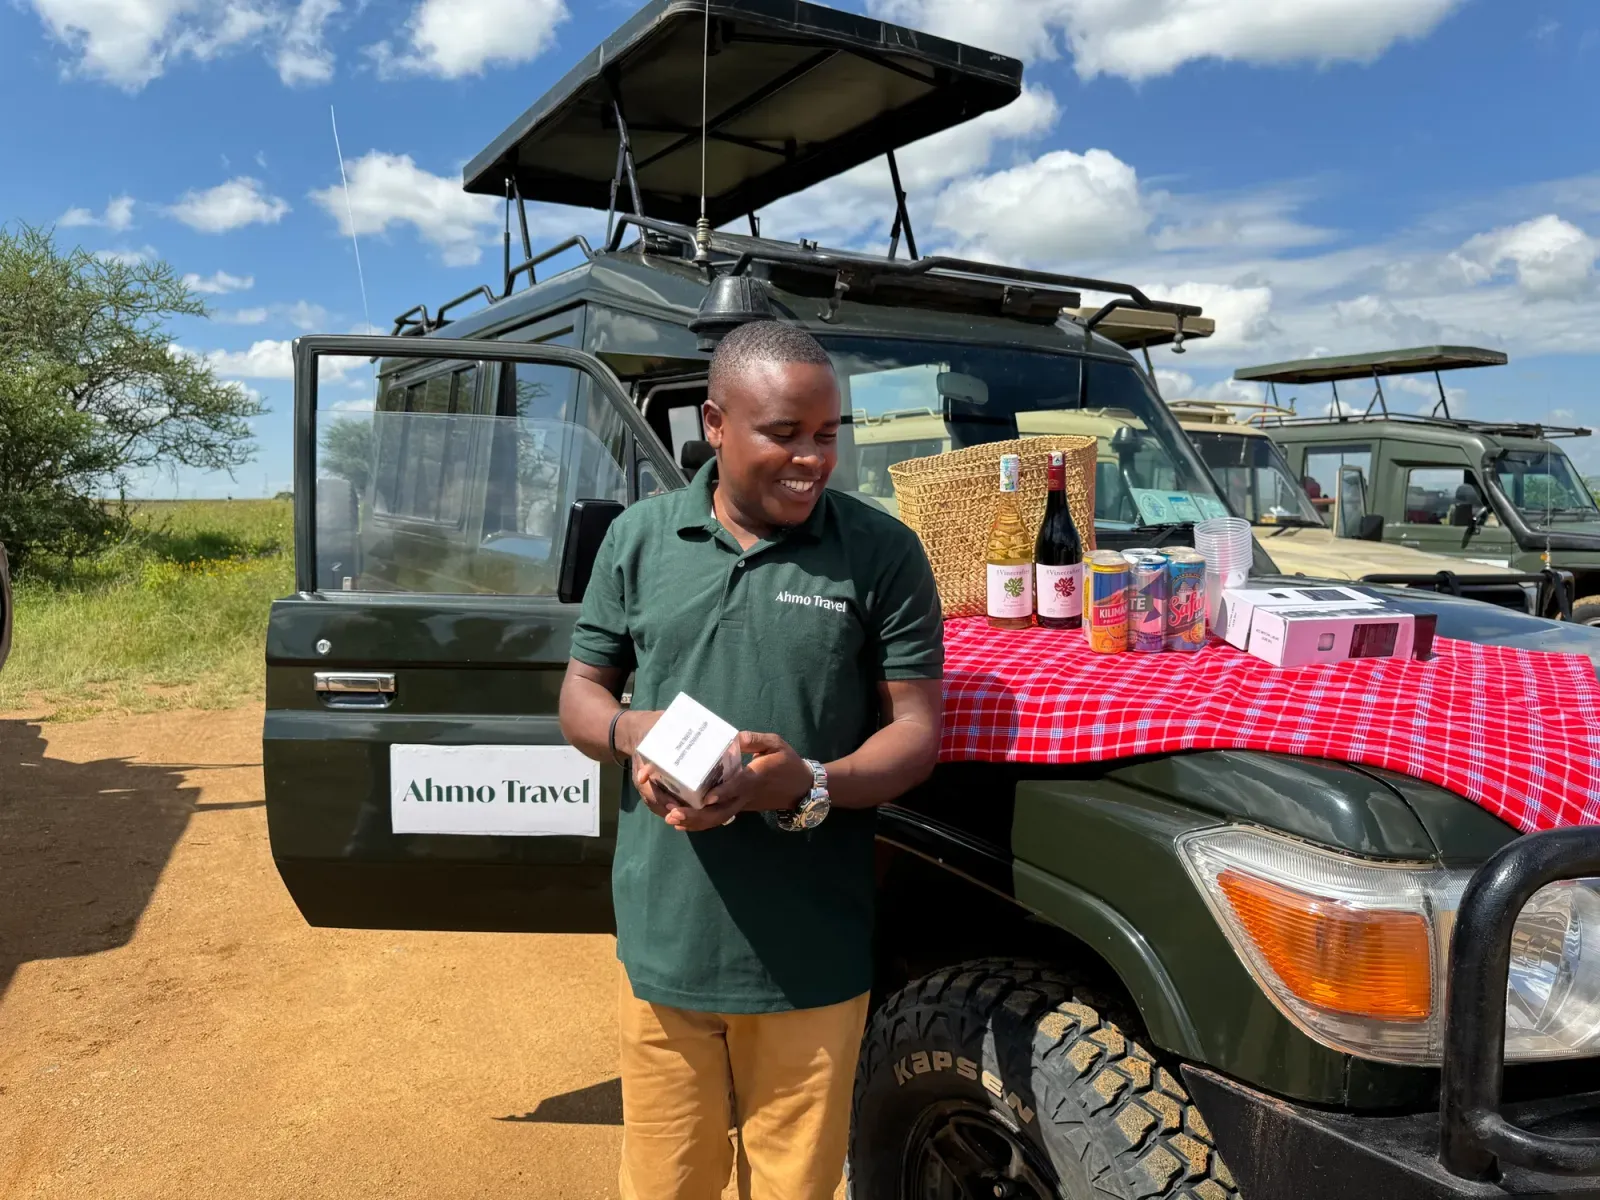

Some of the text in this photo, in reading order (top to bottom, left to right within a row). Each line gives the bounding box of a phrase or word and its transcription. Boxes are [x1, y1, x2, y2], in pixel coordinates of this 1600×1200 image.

[775, 591, 847, 613] Ahmo Travel
[403, 777, 590, 804] Ahmo Travel
